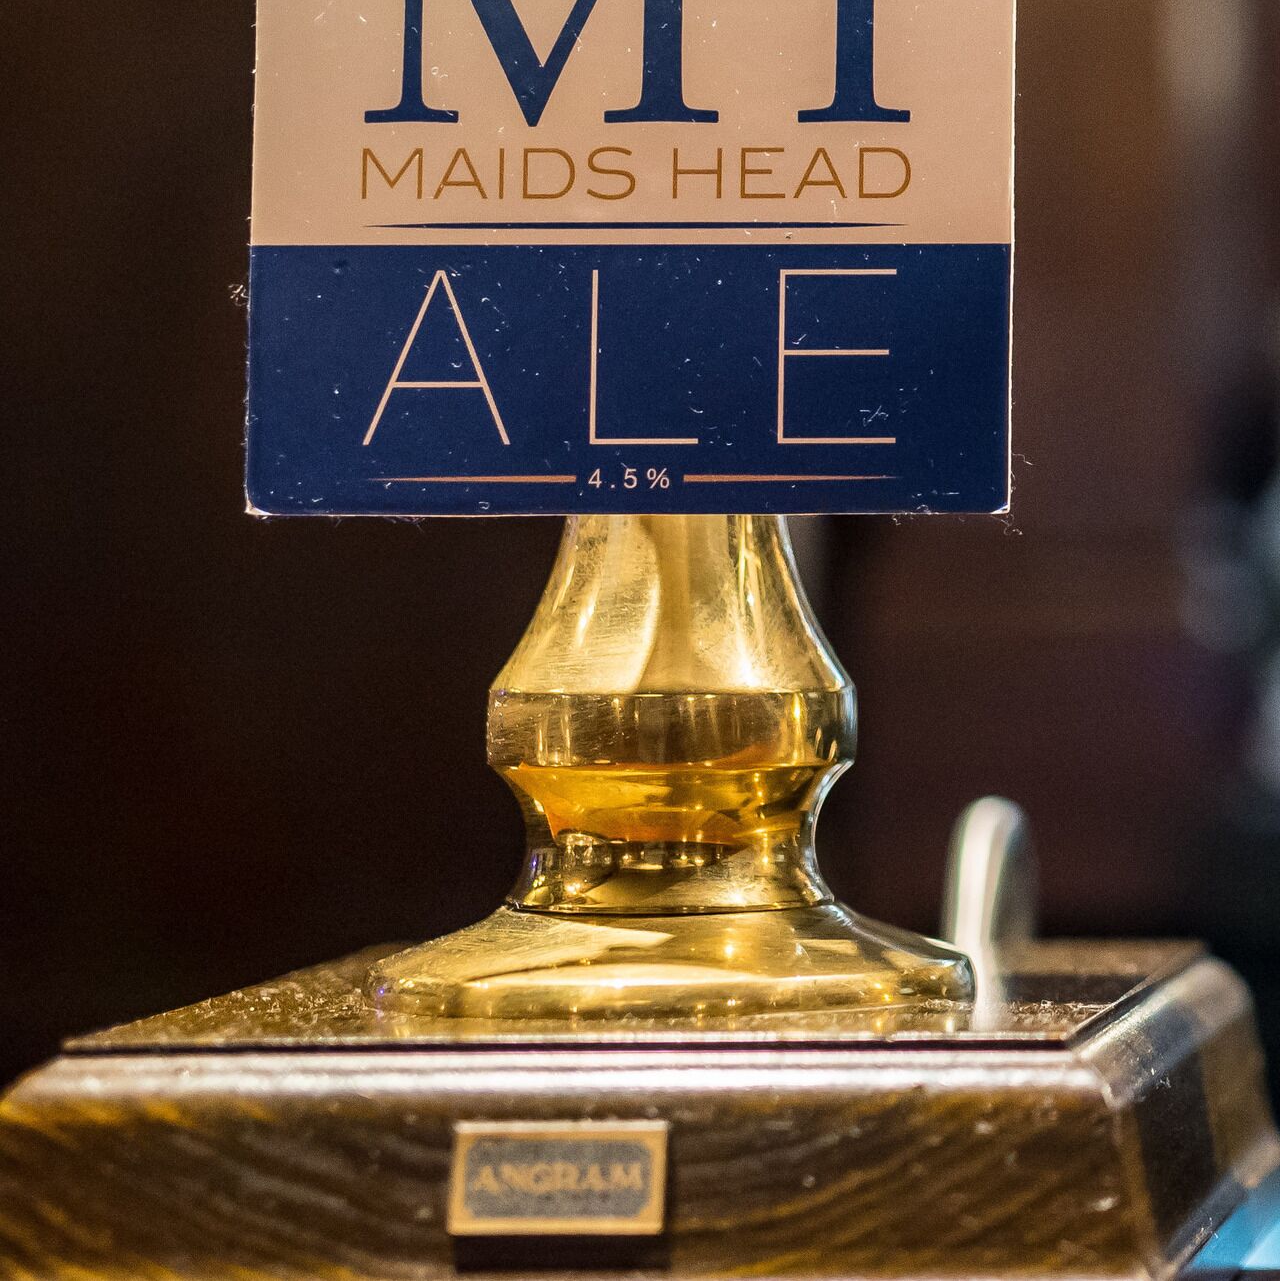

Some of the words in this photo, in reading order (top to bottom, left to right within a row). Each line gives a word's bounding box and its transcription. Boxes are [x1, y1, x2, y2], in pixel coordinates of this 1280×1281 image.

[360, 146, 637, 200] MAIDS
[671, 146, 912, 200] HEAD
[361, 268, 898, 446] ALE
